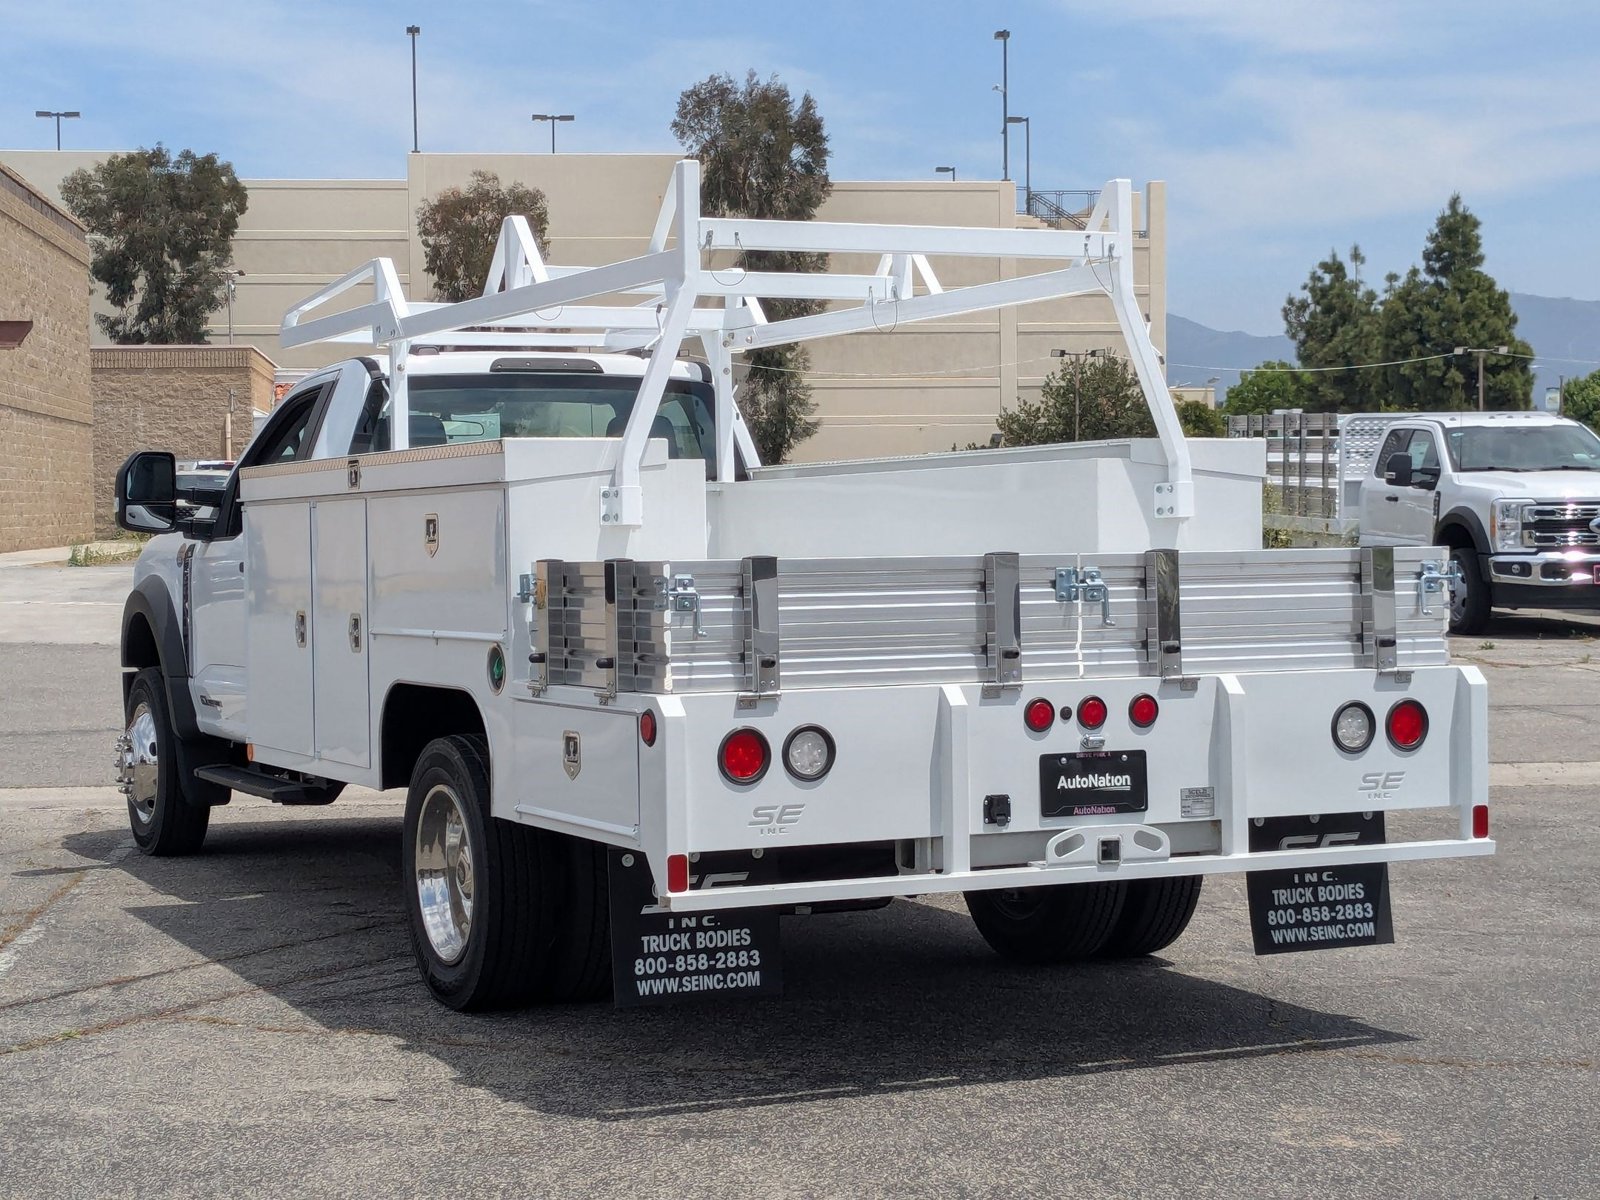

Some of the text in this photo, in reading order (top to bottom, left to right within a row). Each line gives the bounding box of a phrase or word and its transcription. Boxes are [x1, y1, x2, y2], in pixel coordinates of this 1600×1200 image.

[1057, 772, 1131, 790] AutoNation
[1358, 771, 1406, 791] SE
[748, 804, 806, 827] SE
[1073, 806, 1116, 815] AutoNation
[1294, 871, 1338, 884] INC.
[1271, 883, 1365, 906] TRUCK BODIES
[668, 915, 721, 929] INC.
[1267, 902, 1374, 926] 800-858-2883
[641, 928, 751, 953] TRUCK BODIES
[1270, 922, 1375, 945] WWW.SEINC.COM
[634, 949, 761, 976] 800-858-2883
[636, 970, 761, 997] WWW.SEINC.COM
